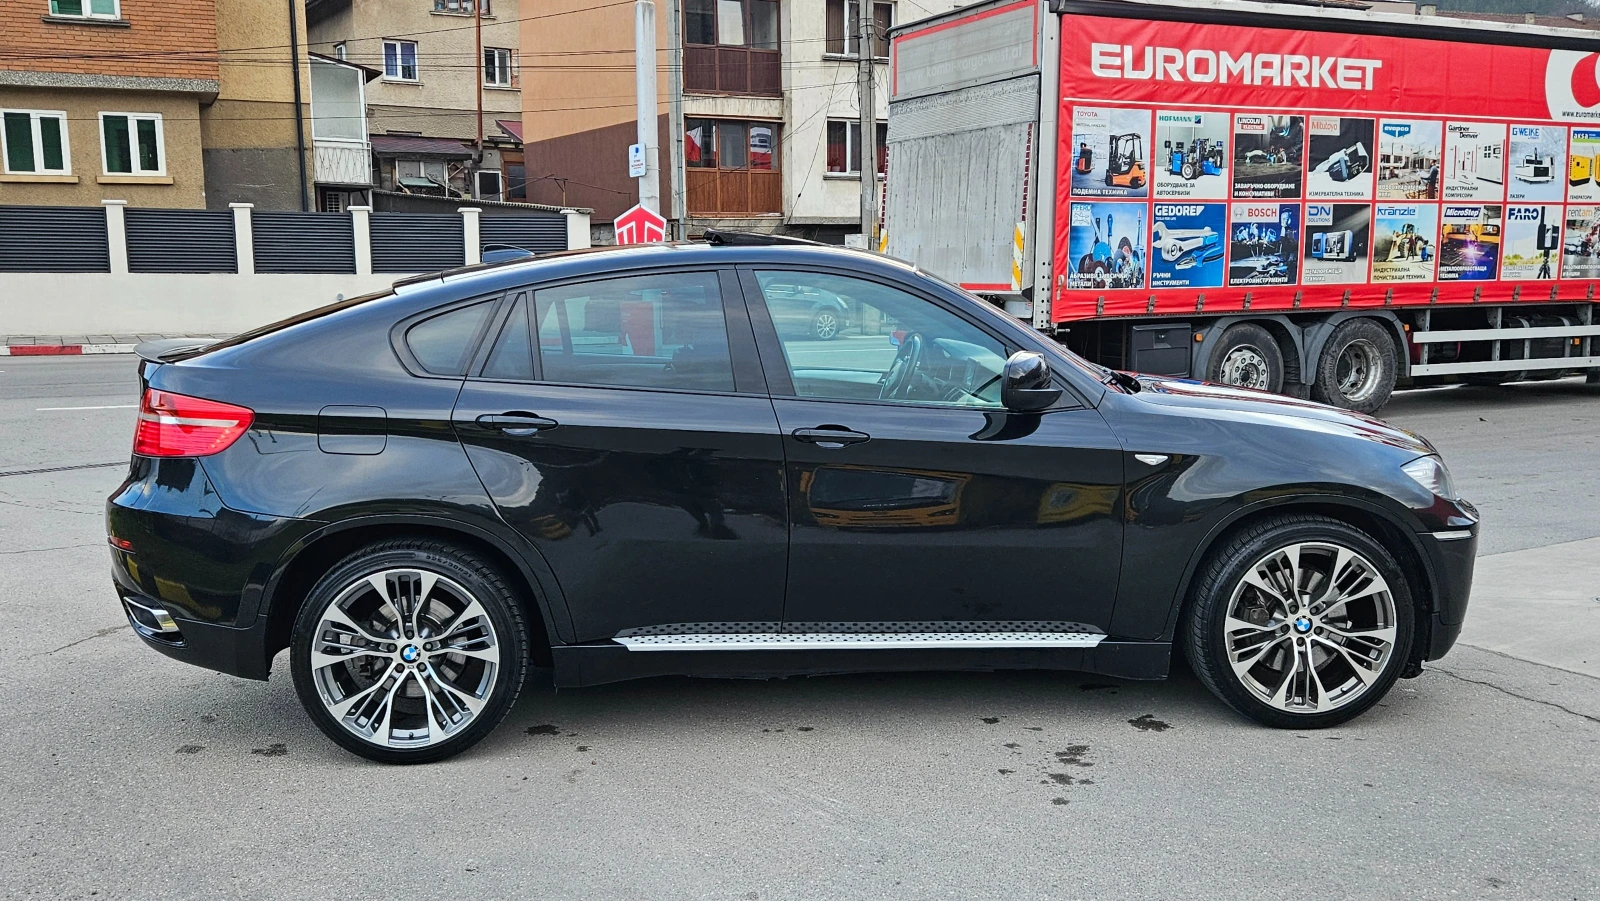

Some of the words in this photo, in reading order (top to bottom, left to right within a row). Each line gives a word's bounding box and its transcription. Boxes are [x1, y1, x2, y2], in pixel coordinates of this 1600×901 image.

[1091, 42, 1382, 91] EUROMARKET
[1518, 128, 1539, 136] WEIKE
[1155, 205, 1197, 216] GEDORE
[1247, 208, 1277, 217] BOSCH
[1308, 205, 1331, 216] DN
[1446, 208, 1479, 217] MicroStep
[1508, 208, 1539, 220] FARO
